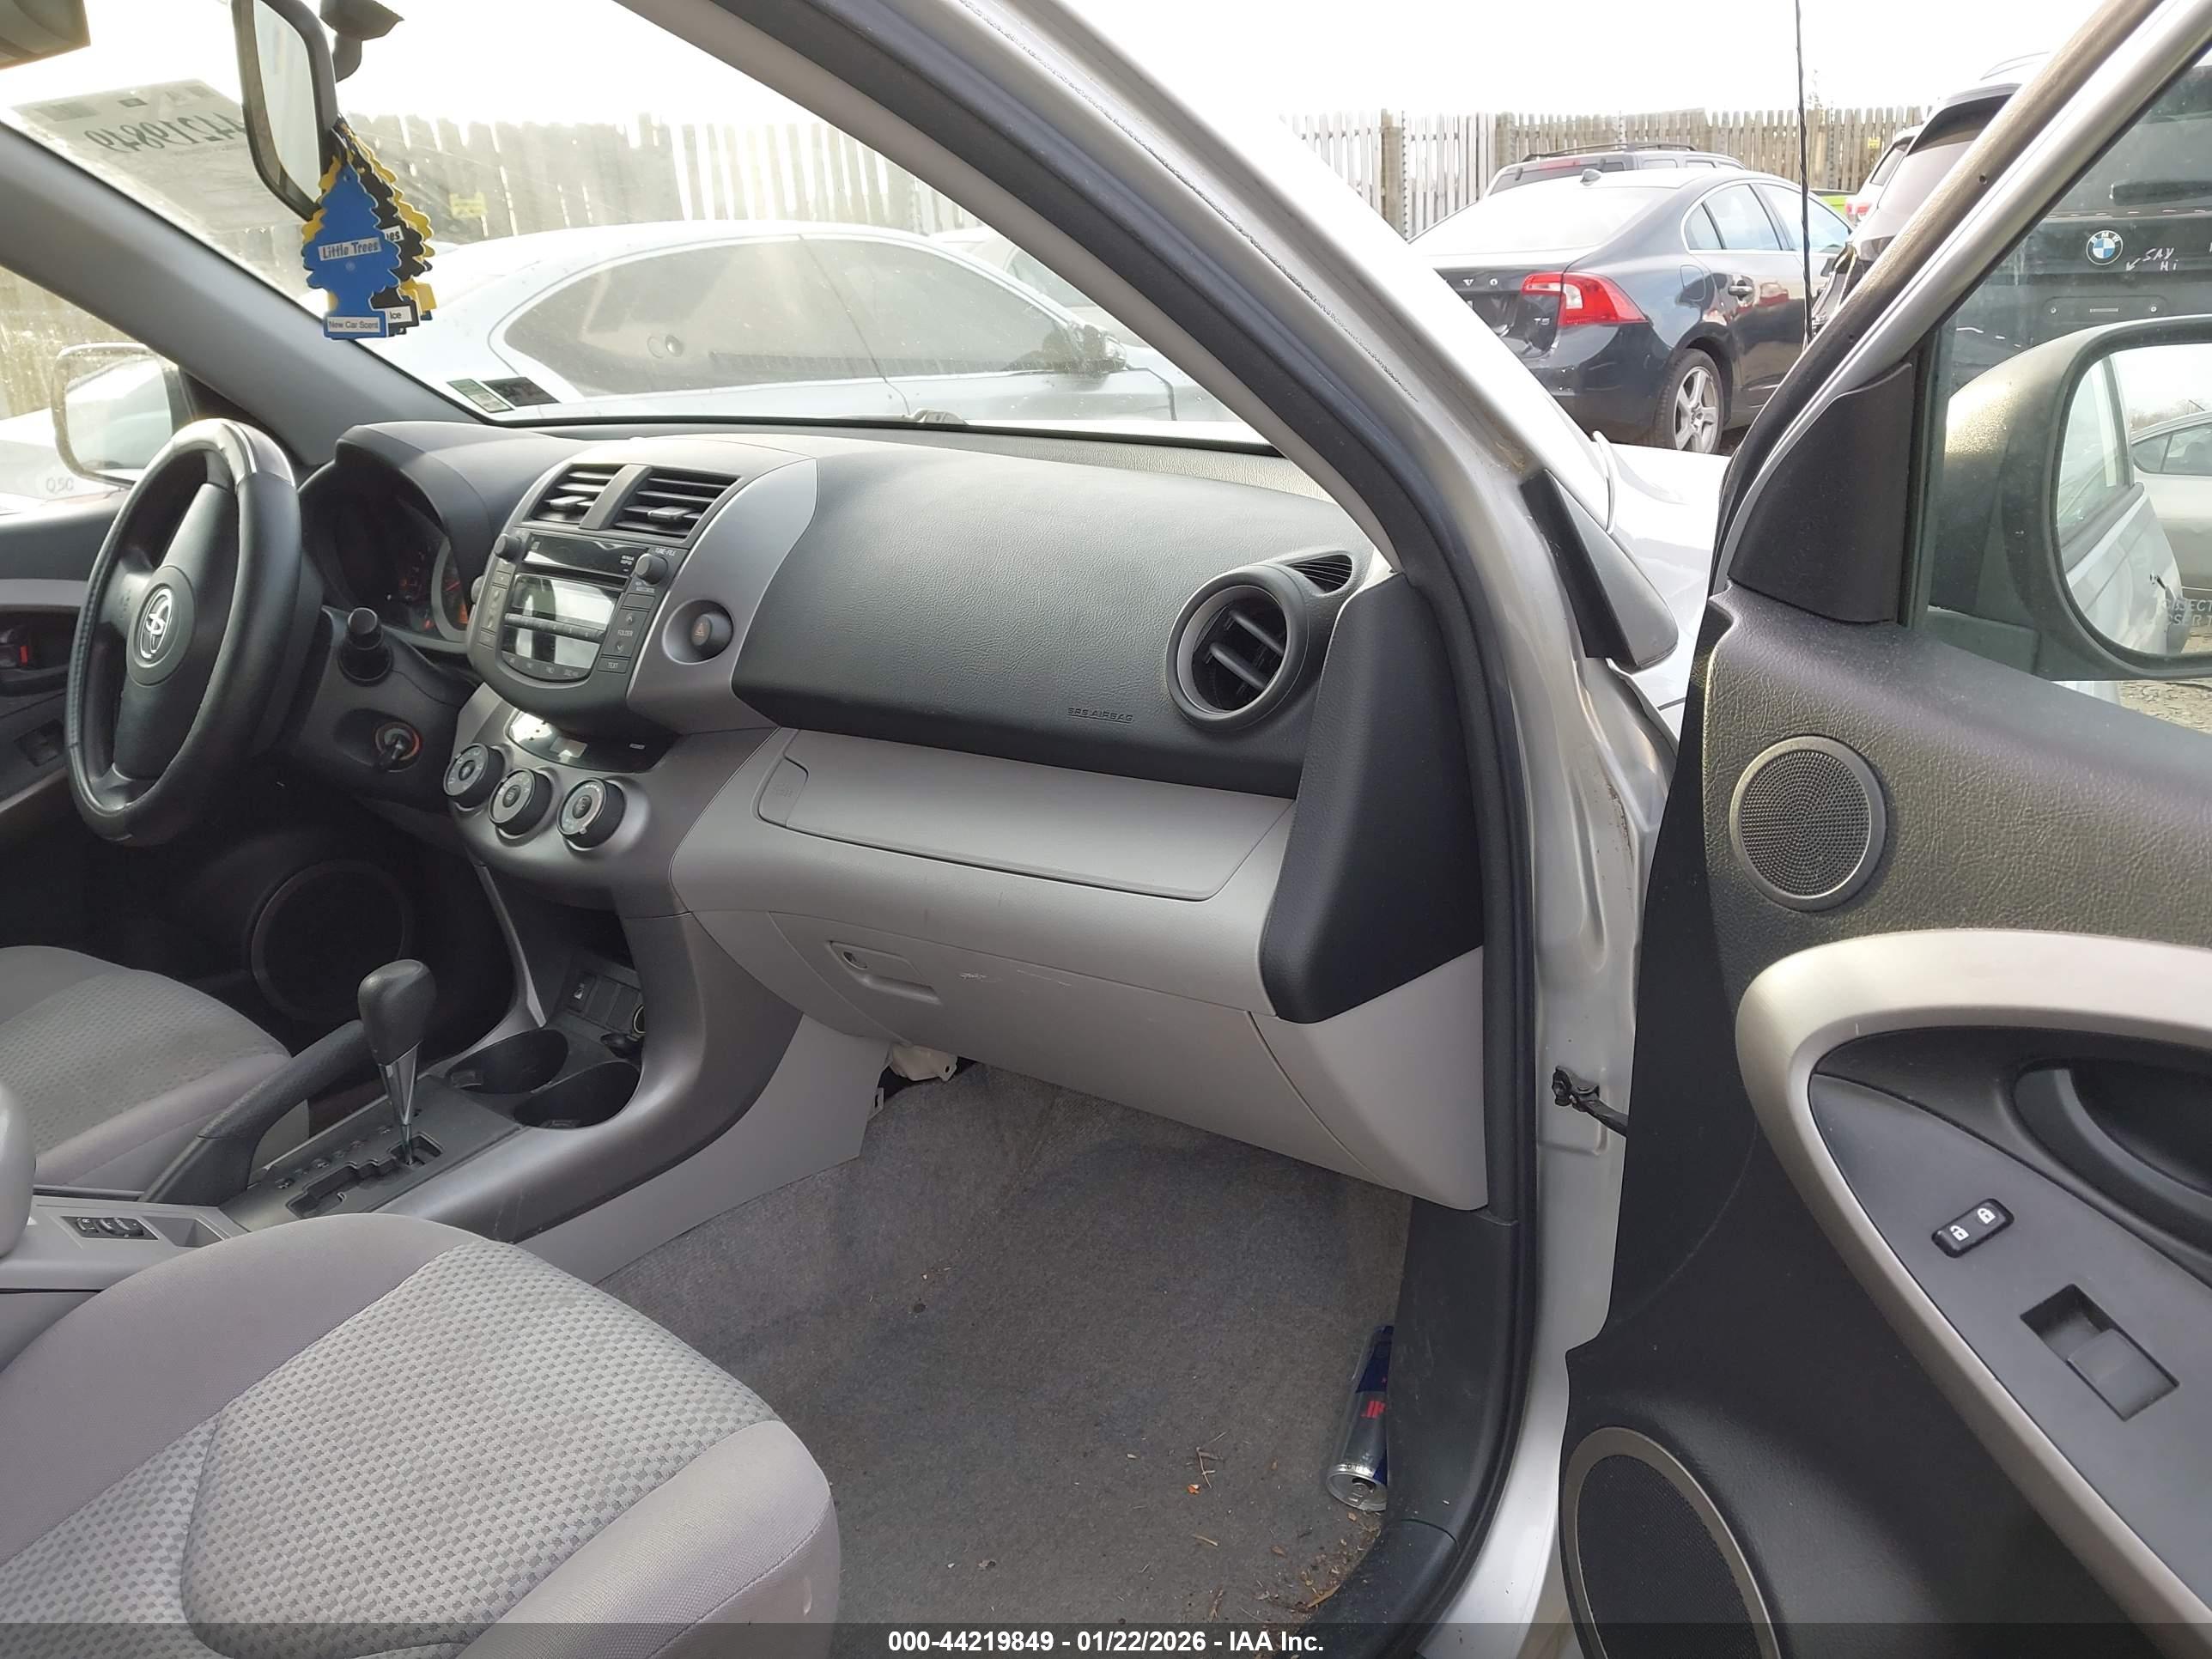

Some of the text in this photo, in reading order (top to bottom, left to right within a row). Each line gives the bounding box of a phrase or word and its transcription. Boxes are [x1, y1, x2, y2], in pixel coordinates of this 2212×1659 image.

[322, 240, 378, 258] Little Trees
[2142, 247, 2174, 261] SAY
[389, 311, 402, 319] Ice
[1534, 316, 1550, 325] T5
[328, 320, 379, 329] New Car Scent
[1067, 707, 1133, 722] SRS AIRBAG
